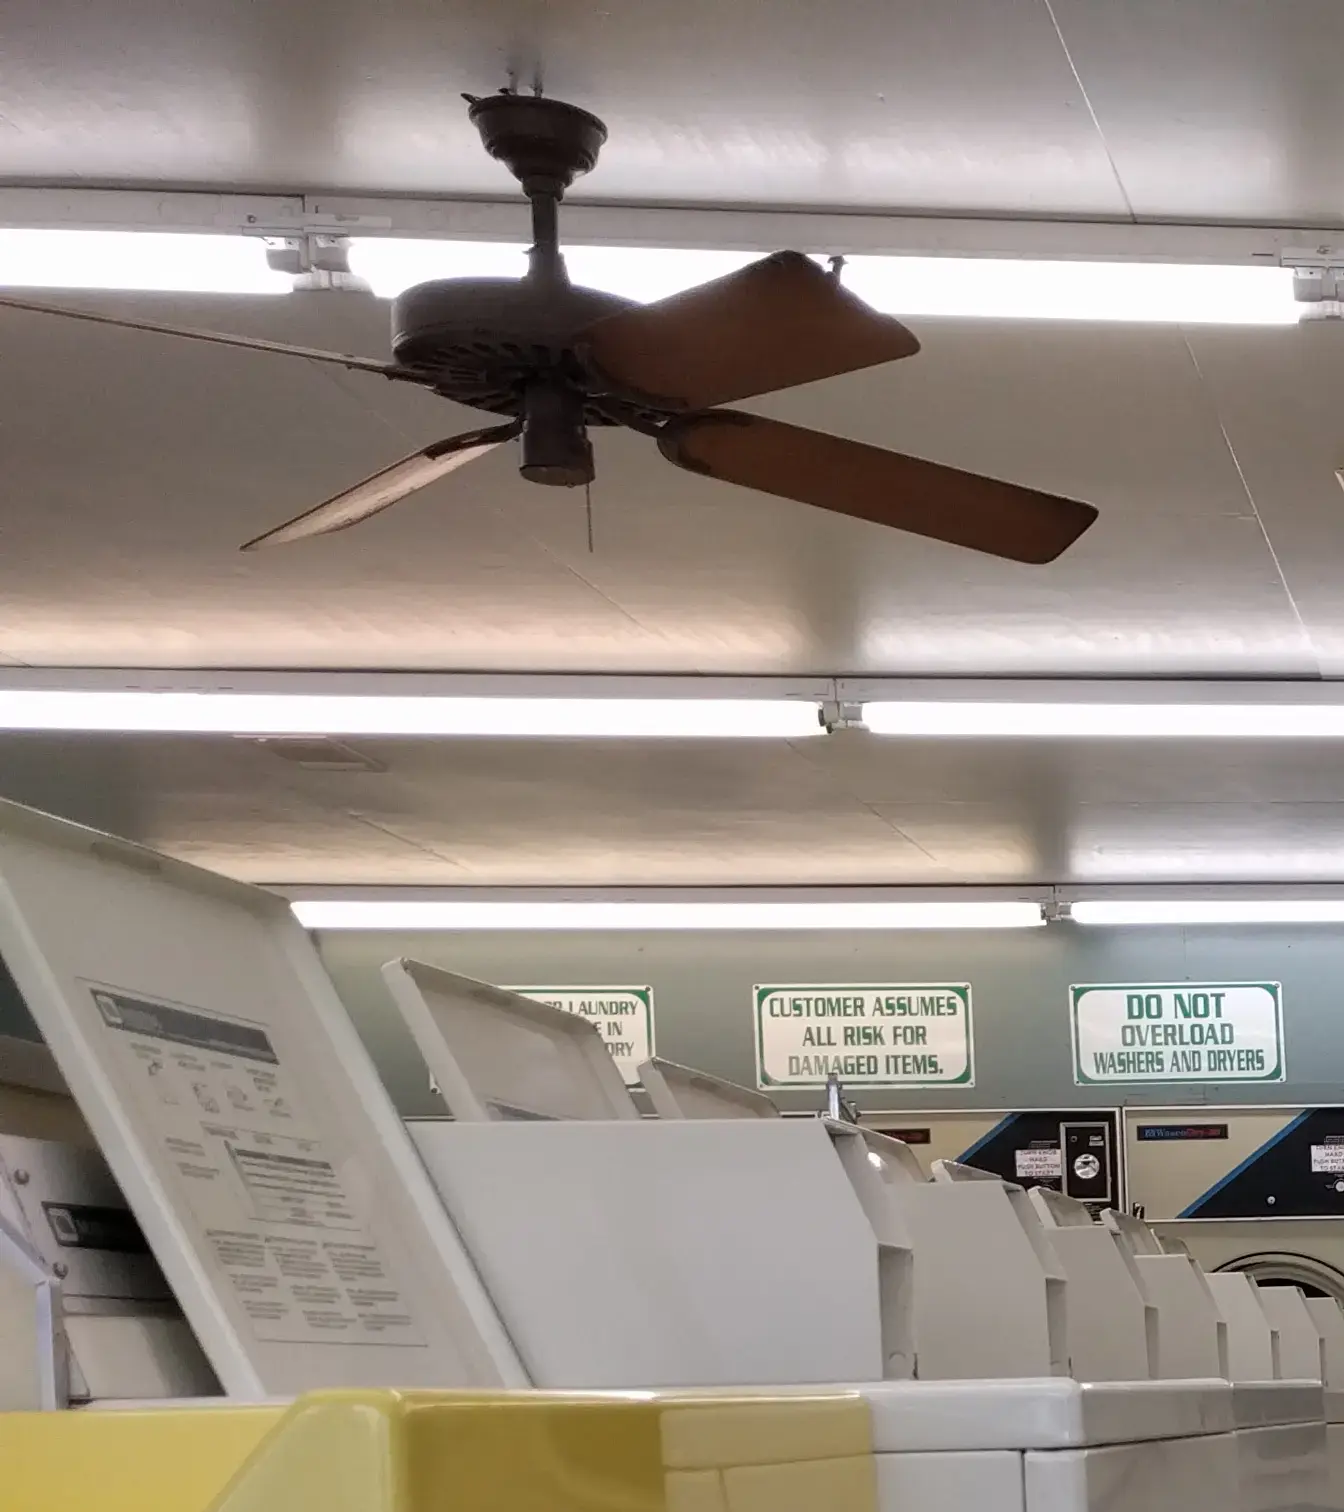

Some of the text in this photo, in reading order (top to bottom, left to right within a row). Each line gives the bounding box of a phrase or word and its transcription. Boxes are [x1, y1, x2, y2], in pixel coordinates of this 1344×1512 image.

[769, 996, 958, 1017] CUSTOMER ASSUMES
[1126, 992, 1226, 1020] DO NOT
[607, 1021, 623, 1036] IN
[802, 1025, 928, 1047] ALL RISK FOR
[1121, 1023, 1235, 1047] OVERLOAD
[788, 1054, 944, 1076] DAMAGED ITEMS.
[1093, 1048, 1265, 1074] WASHERS AND DRYERS
